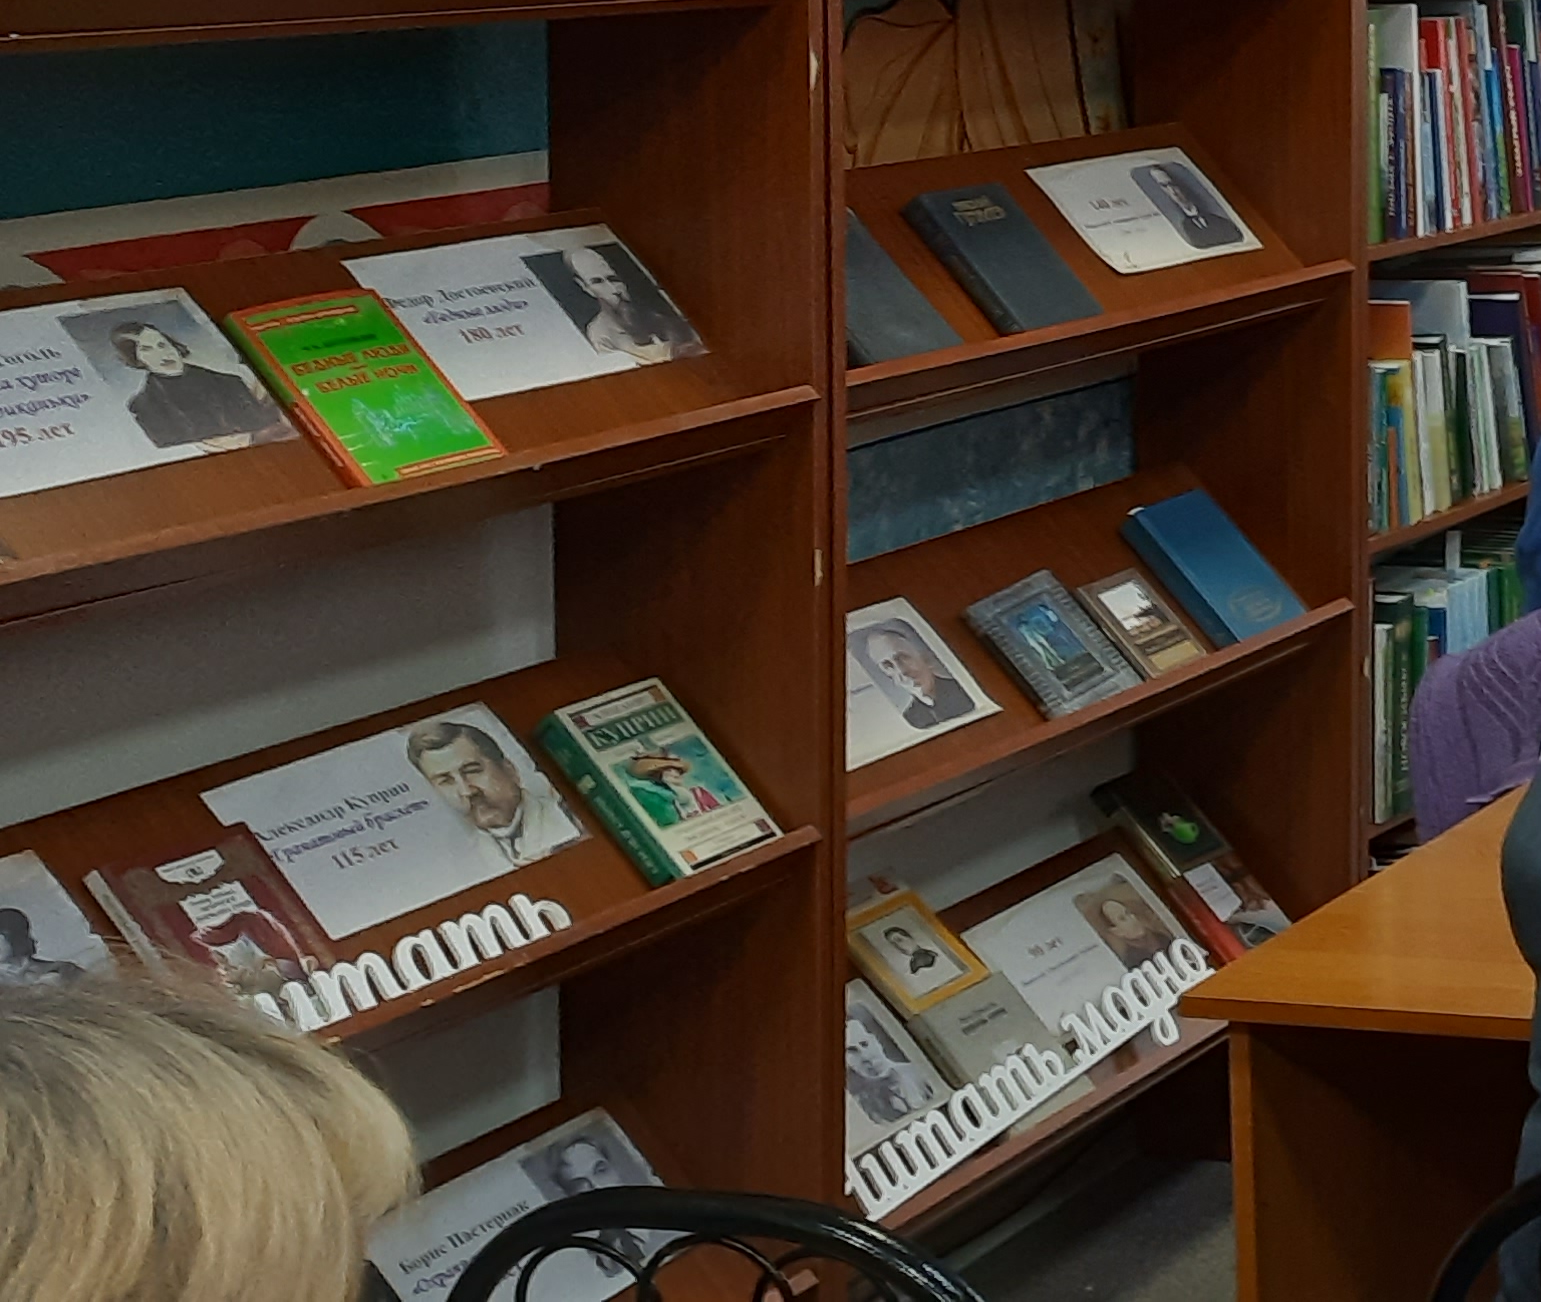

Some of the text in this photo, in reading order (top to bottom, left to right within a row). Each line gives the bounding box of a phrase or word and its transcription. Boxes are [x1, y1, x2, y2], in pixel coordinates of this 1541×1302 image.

[459, 327, 494, 344] 180
[344, 781, 410, 810] Куприн
[331, 838, 399, 869] 115 лет
[1058, 935, 1217, 1065] модно
[398, 1200, 531, 1275] Борис Пастернак
